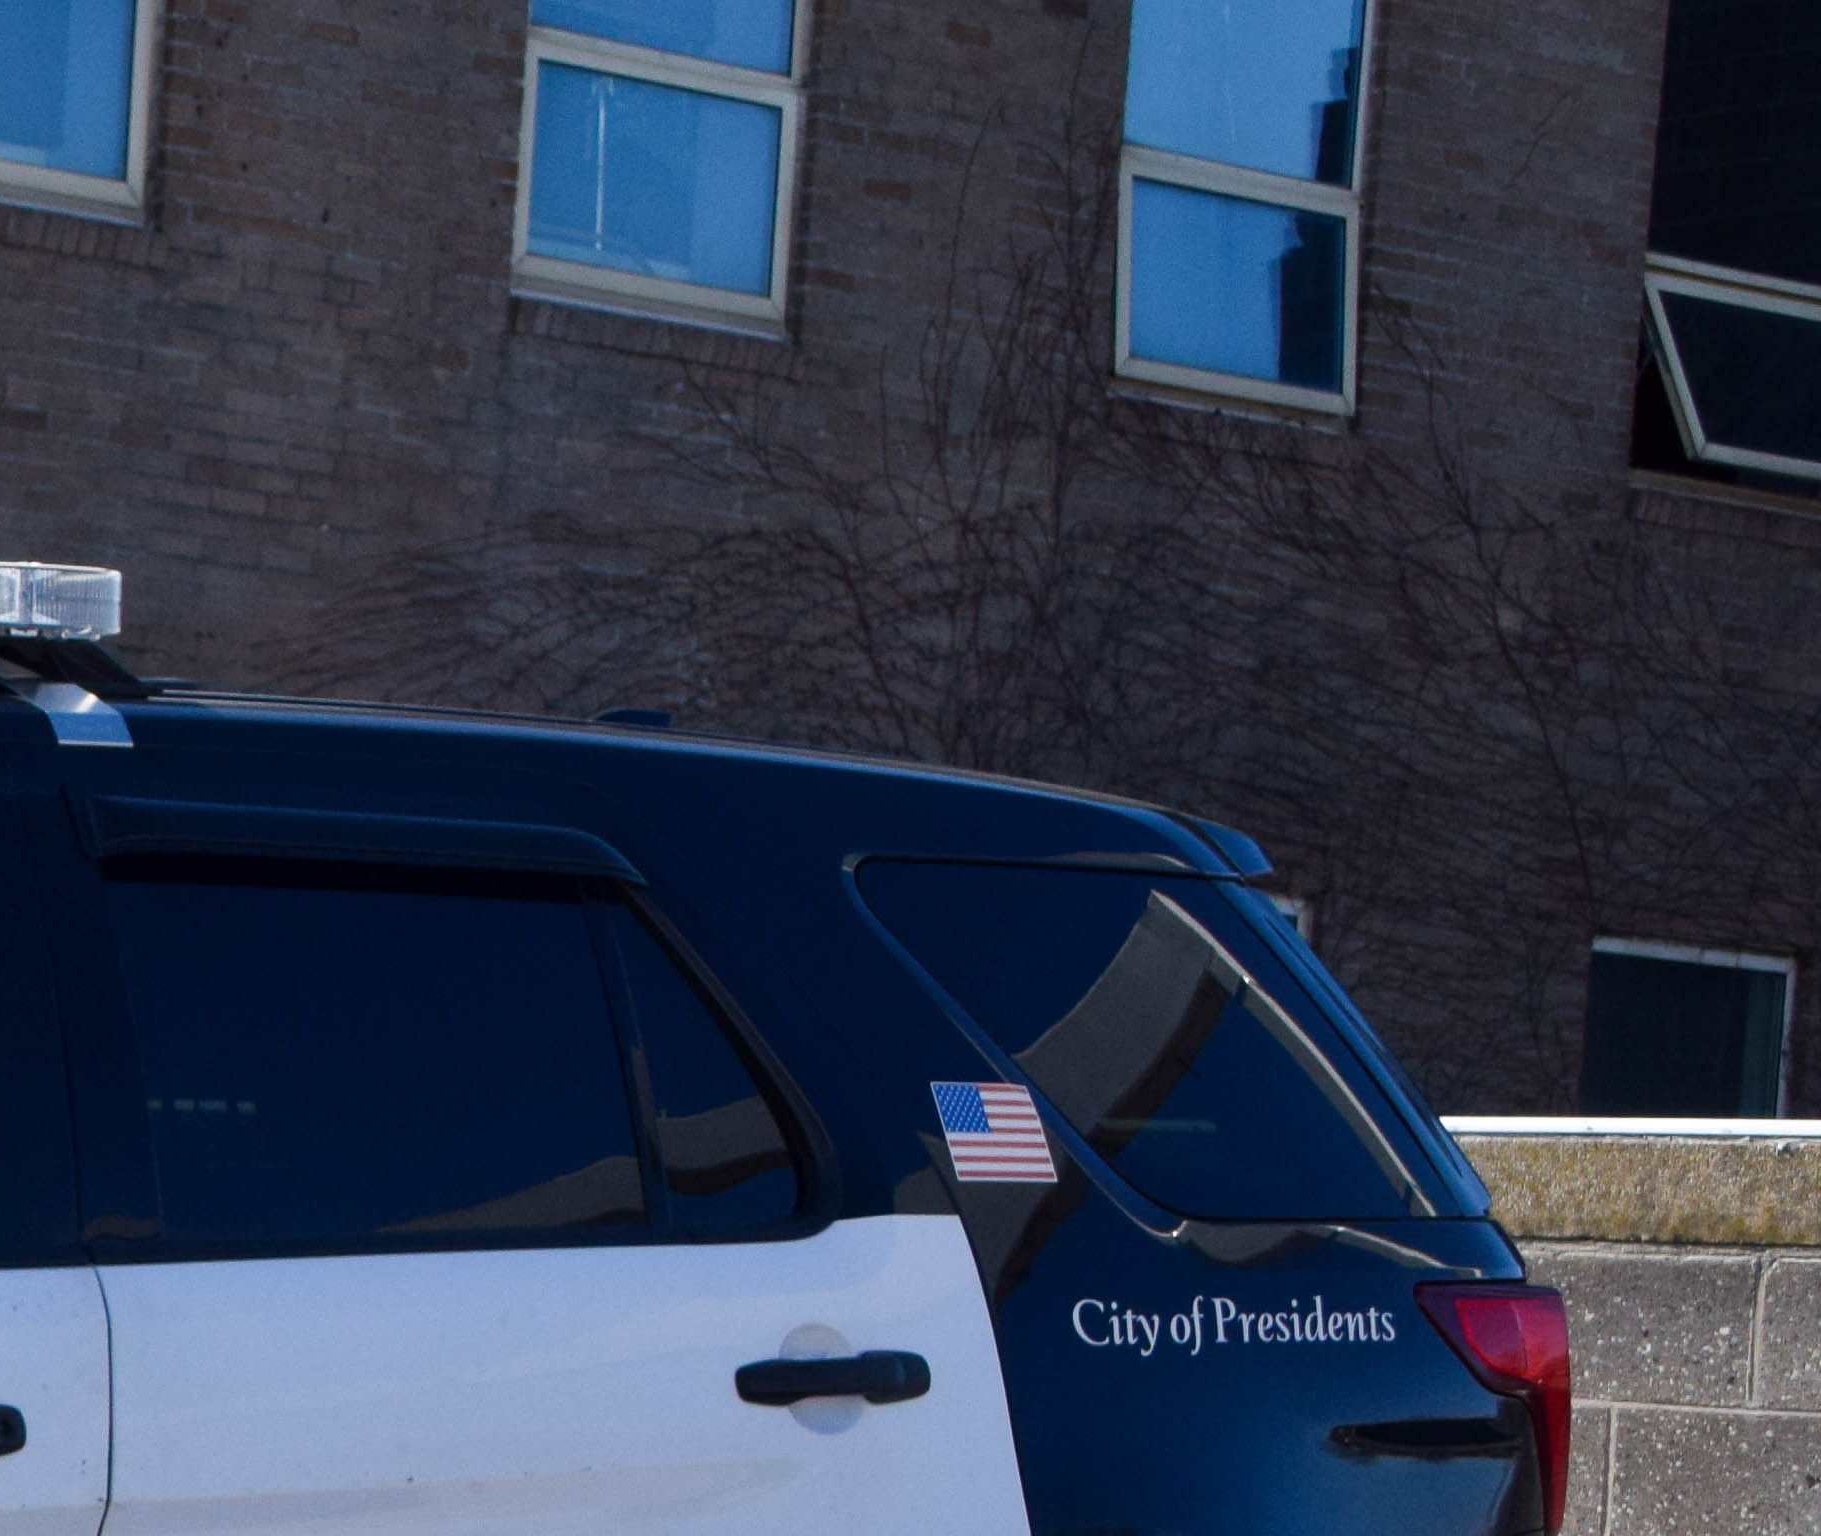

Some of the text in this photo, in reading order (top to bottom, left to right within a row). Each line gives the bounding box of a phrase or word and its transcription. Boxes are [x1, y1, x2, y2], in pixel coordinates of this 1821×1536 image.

[1071, 1295, 1397, 1357] City of Presidents
